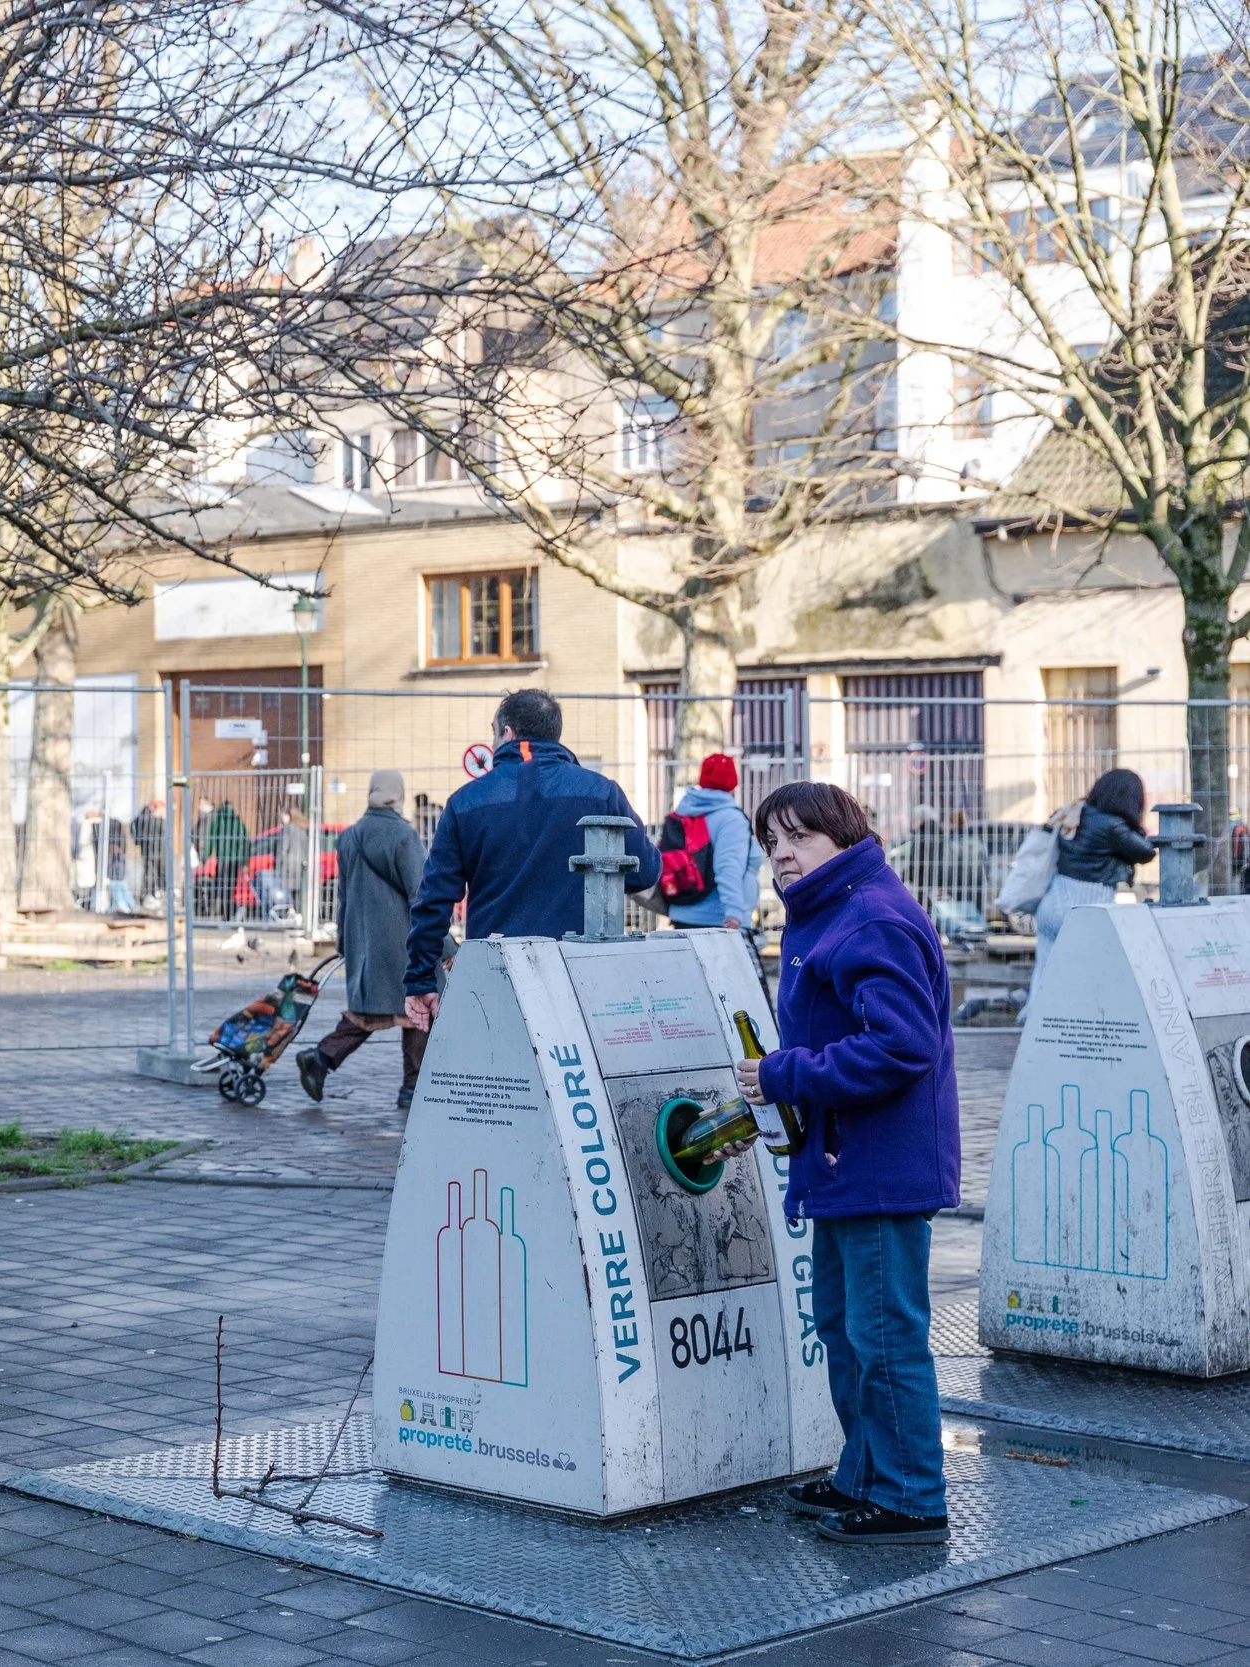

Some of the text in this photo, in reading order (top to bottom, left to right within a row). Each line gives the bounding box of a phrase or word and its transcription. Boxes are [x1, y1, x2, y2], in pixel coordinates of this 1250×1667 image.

[505, 1084, 530, 1092] poursuites
[1151, 977, 1210, 1124] BLANC
[550, 1043, 641, 1384] VERRE COLORÉ
[669, 1306, 754, 1369] 8044
[792, 1255, 824, 1368] GLAS
[398, 1386, 472, 1406] BRUXELLES-PROPRETÉ
